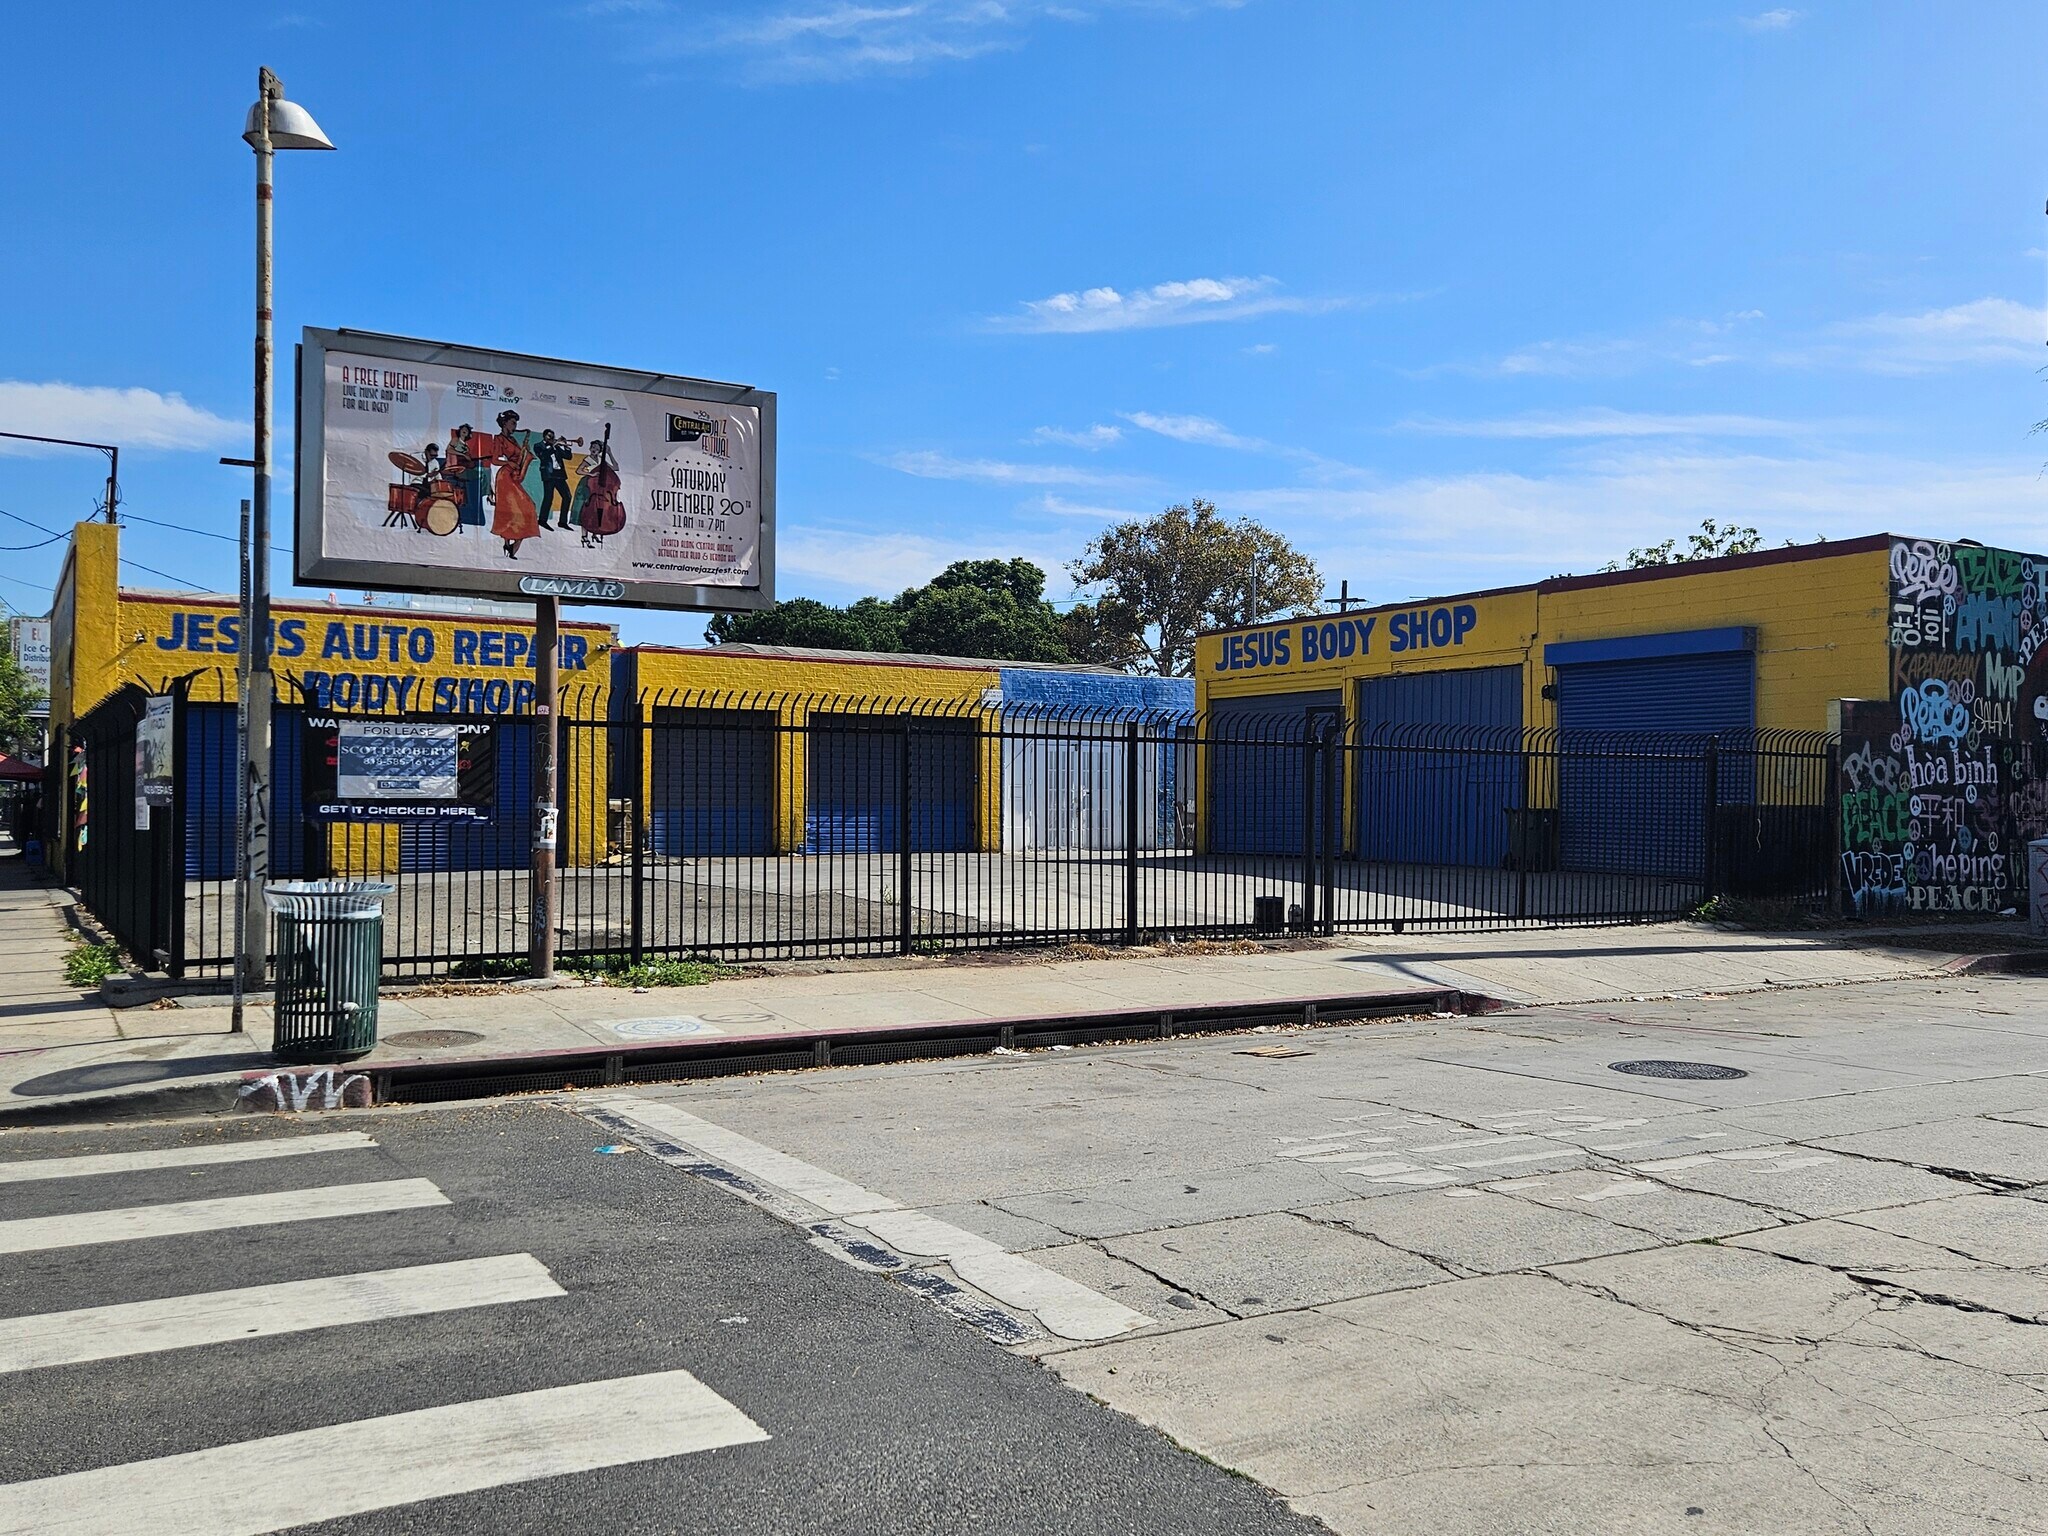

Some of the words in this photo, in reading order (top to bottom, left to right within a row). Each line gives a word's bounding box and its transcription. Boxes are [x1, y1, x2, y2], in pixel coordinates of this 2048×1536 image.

[343, 365, 349, 383] A
[354, 367, 379, 387] FREE
[384, 371, 418, 391] EVENT!
[457, 380, 487, 390] CURREN
[343, 384, 356, 397] LIVE
[360, 386, 379, 400] MUSIC
[381, 389, 394, 401] AND
[396, 391, 408, 403] FUN
[343, 397, 356, 410] FOR
[358, 399, 369, 412] ALL
[372, 401, 389, 414] AGES!
[673, 416, 700, 430] CENTRAL
[711, 419, 726, 436] JAZZ
[702, 435, 730, 458] FESTIVAL
[671, 467, 726, 493] SATURDAY
[651, 489, 714, 515] SEPTEMBER
[661, 538, 679, 548] LOCATED
[681, 540, 694, 549] ALONG
[696, 541, 715, 551] CENTRAL
[717, 543, 733, 552] AVENUE
[658, 548, 678, 558] BETWEEN
[702, 552, 708, 560] &
[632, 561, 749, 576] www.centralavejazzfest.com
[530, 578, 617, 596] LAMAR
[156, 613, 307, 657] JESS
[322, 622, 434, 664] AUTO
[1215, 628, 1291, 671] JESUS
[1302, 617, 1376, 663] BODY
[1389, 604, 1477, 652] SHOP
[24, 643, 37, 652] Ice
[24, 665, 47, 675] Candy
[32, 675, 47, 685] Dry
[434, 676, 537, 714] SHOP
[364, 726, 391, 735] FOR
[395, 727, 435, 736] LEASE
[341, 745, 391, 755] SCOTT
[393, 746, 456, 756] ROBERTS
[1905, 744, 1948, 789] hòa
[319, 805, 348, 814] GET
[352, 806, 364, 814] IT
[368, 806, 436, 815] CHECKED
[440, 807, 476, 815] HERE
[1843, 788, 1910, 848] PEACE
[1919, 794, 1965, 836] 平和
[1912, 884, 1997, 911] PEACE
